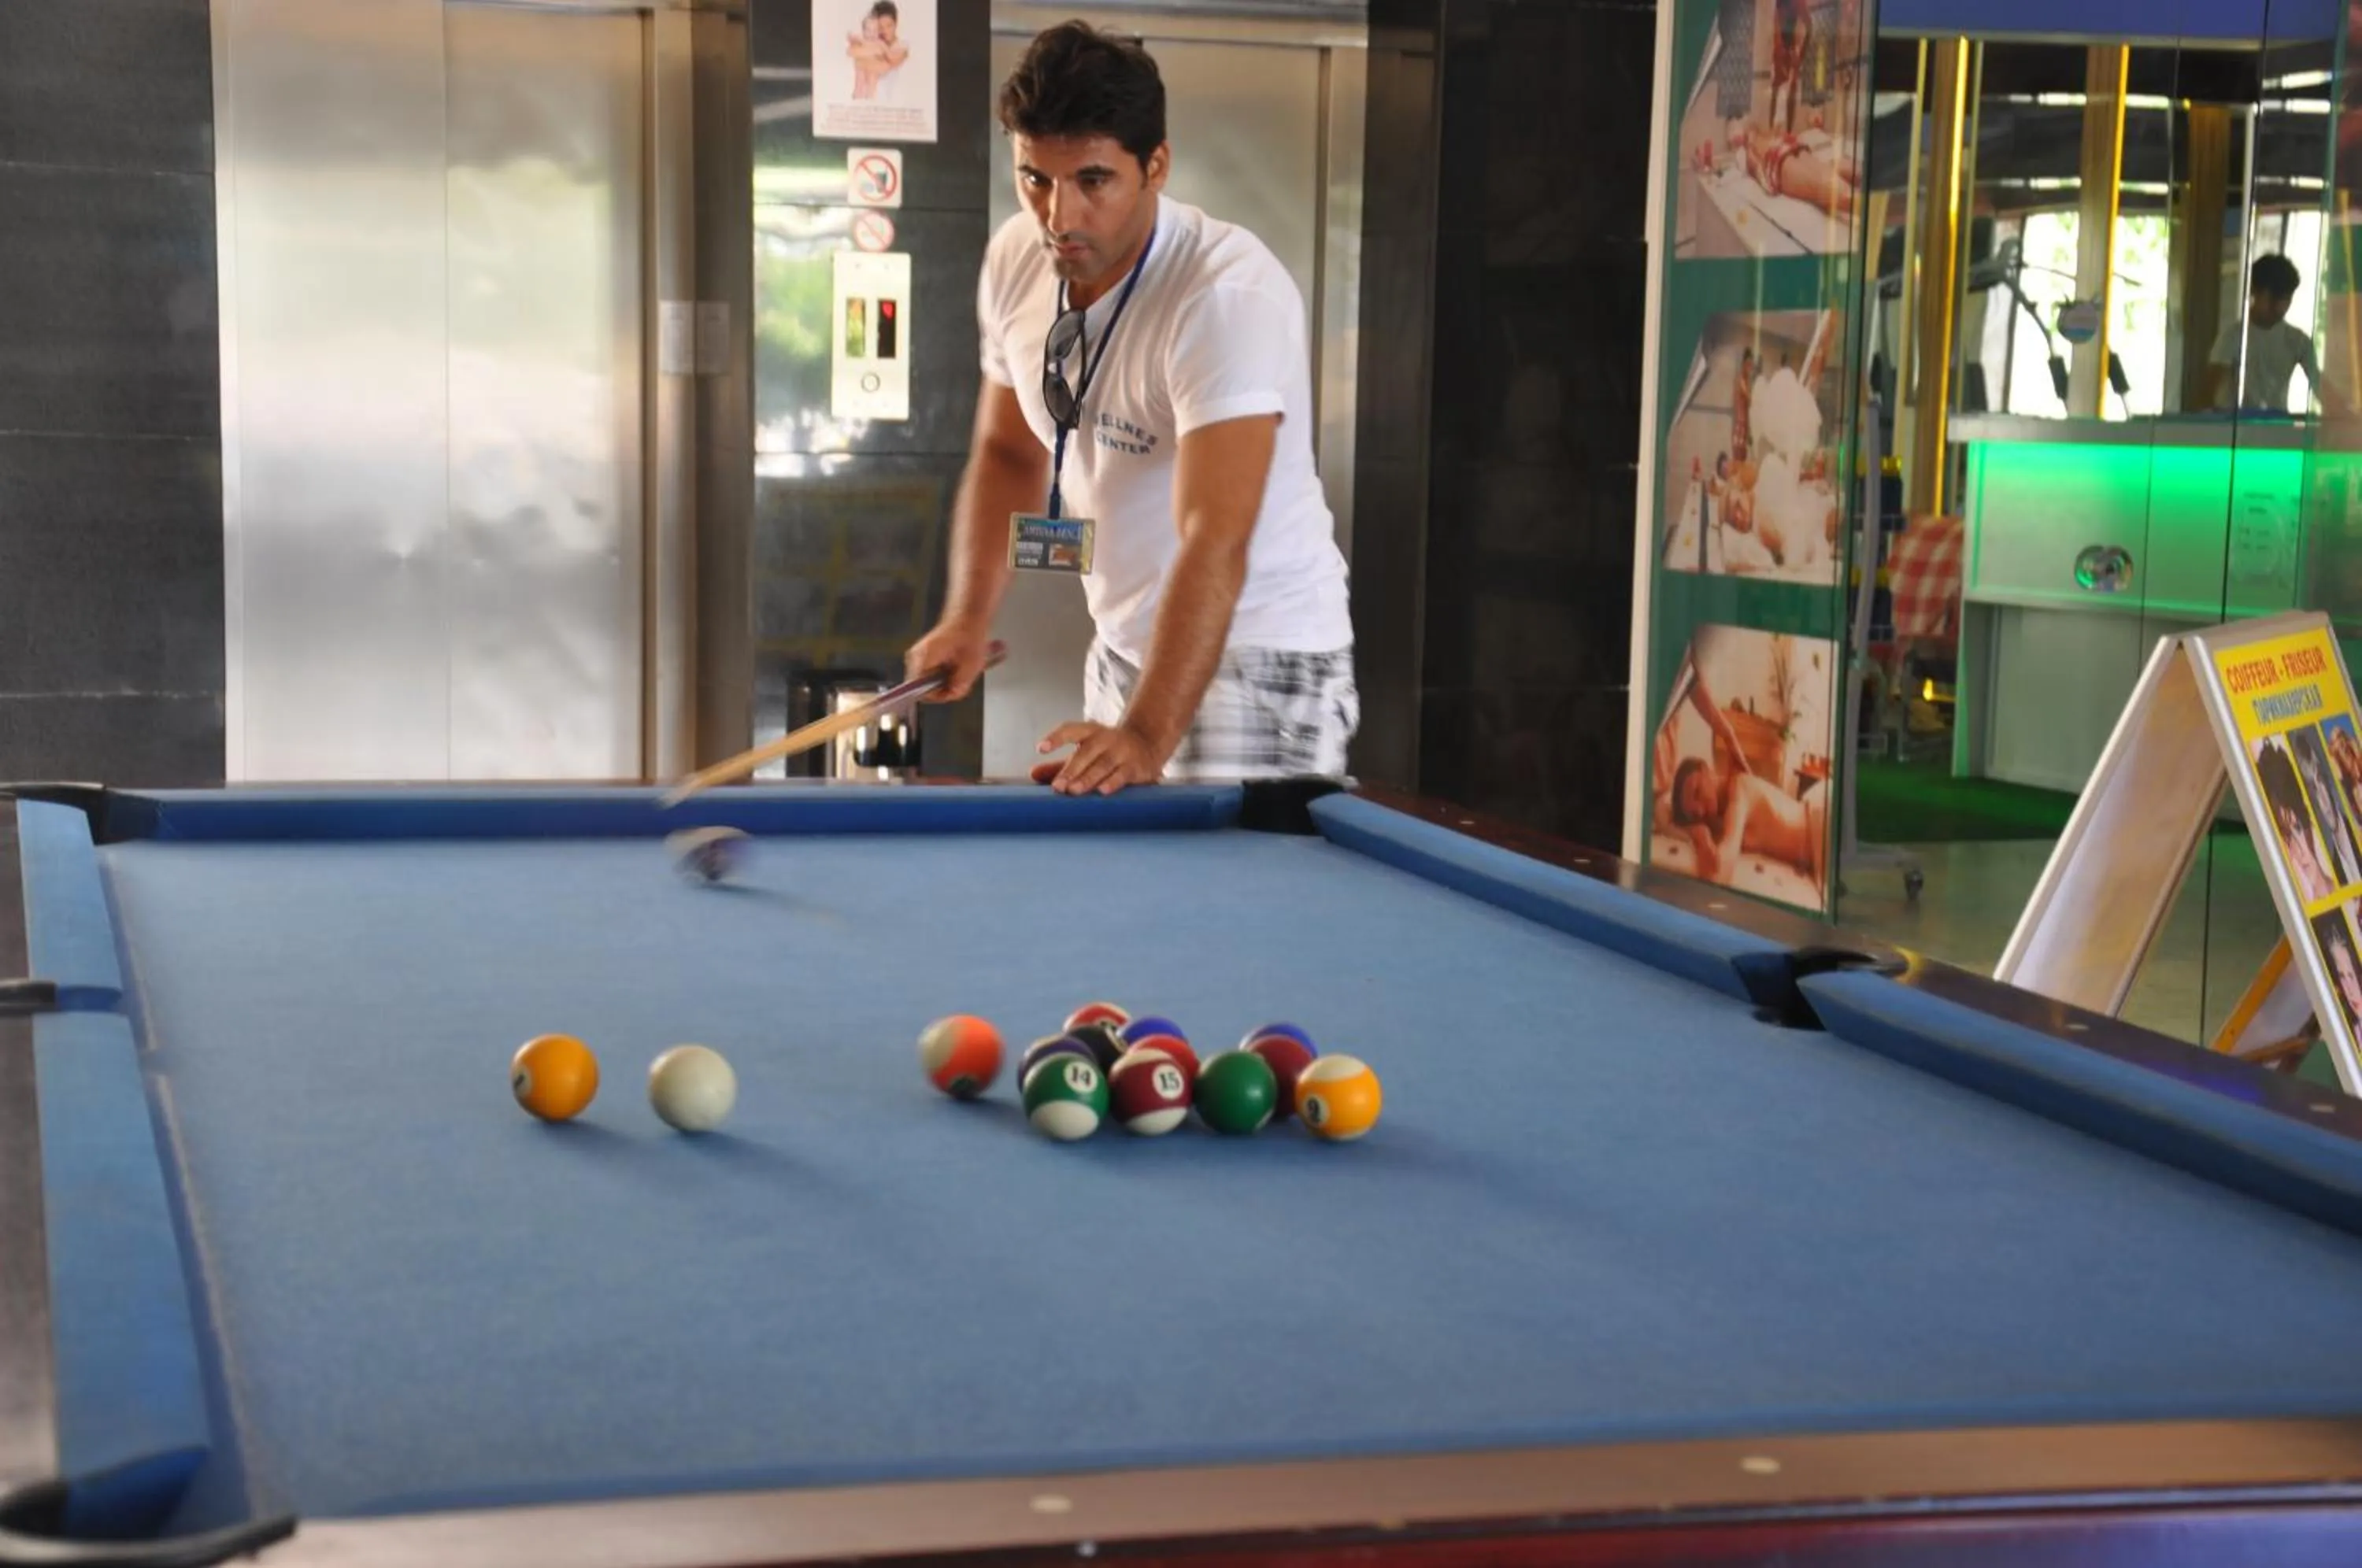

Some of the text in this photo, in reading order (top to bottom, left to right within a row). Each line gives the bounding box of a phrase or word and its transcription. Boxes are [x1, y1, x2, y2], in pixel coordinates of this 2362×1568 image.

[1096, 431, 1151, 454] CENTER
[2226, 657, 2280, 694] COIFFEUR
[2282, 646, 2327, 680] FRISEUR
[1071, 1066, 1092, 1086] 14
[1159, 1071, 1180, 1091] 15
